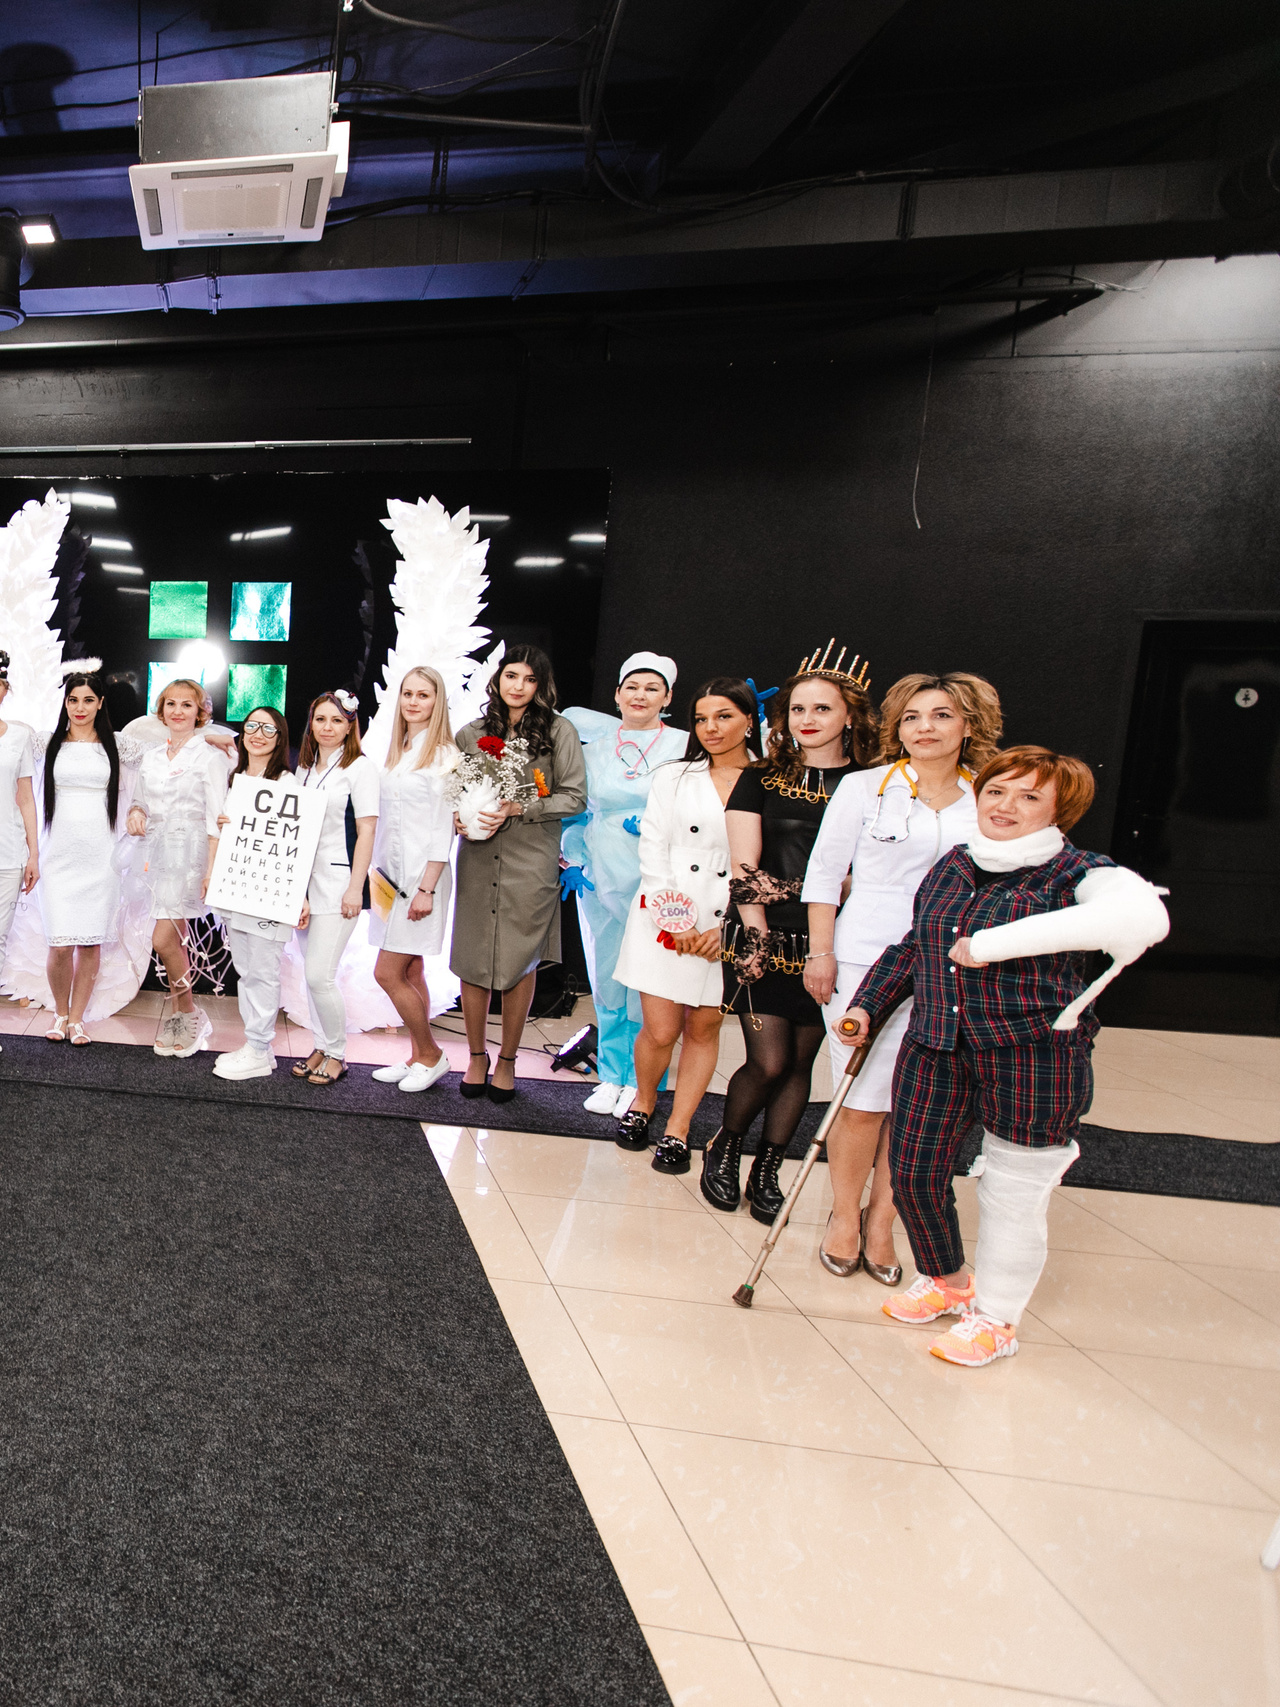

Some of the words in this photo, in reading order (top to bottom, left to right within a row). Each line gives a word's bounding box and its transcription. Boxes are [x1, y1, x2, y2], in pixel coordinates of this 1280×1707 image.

[254, 789, 301, 821] СД
[240, 816, 300, 840] НЁМ
[235, 836, 298, 858] МЕДИ
[230, 853, 294, 873] ЦИНСК
[656, 914, 694, 931] САХАР
